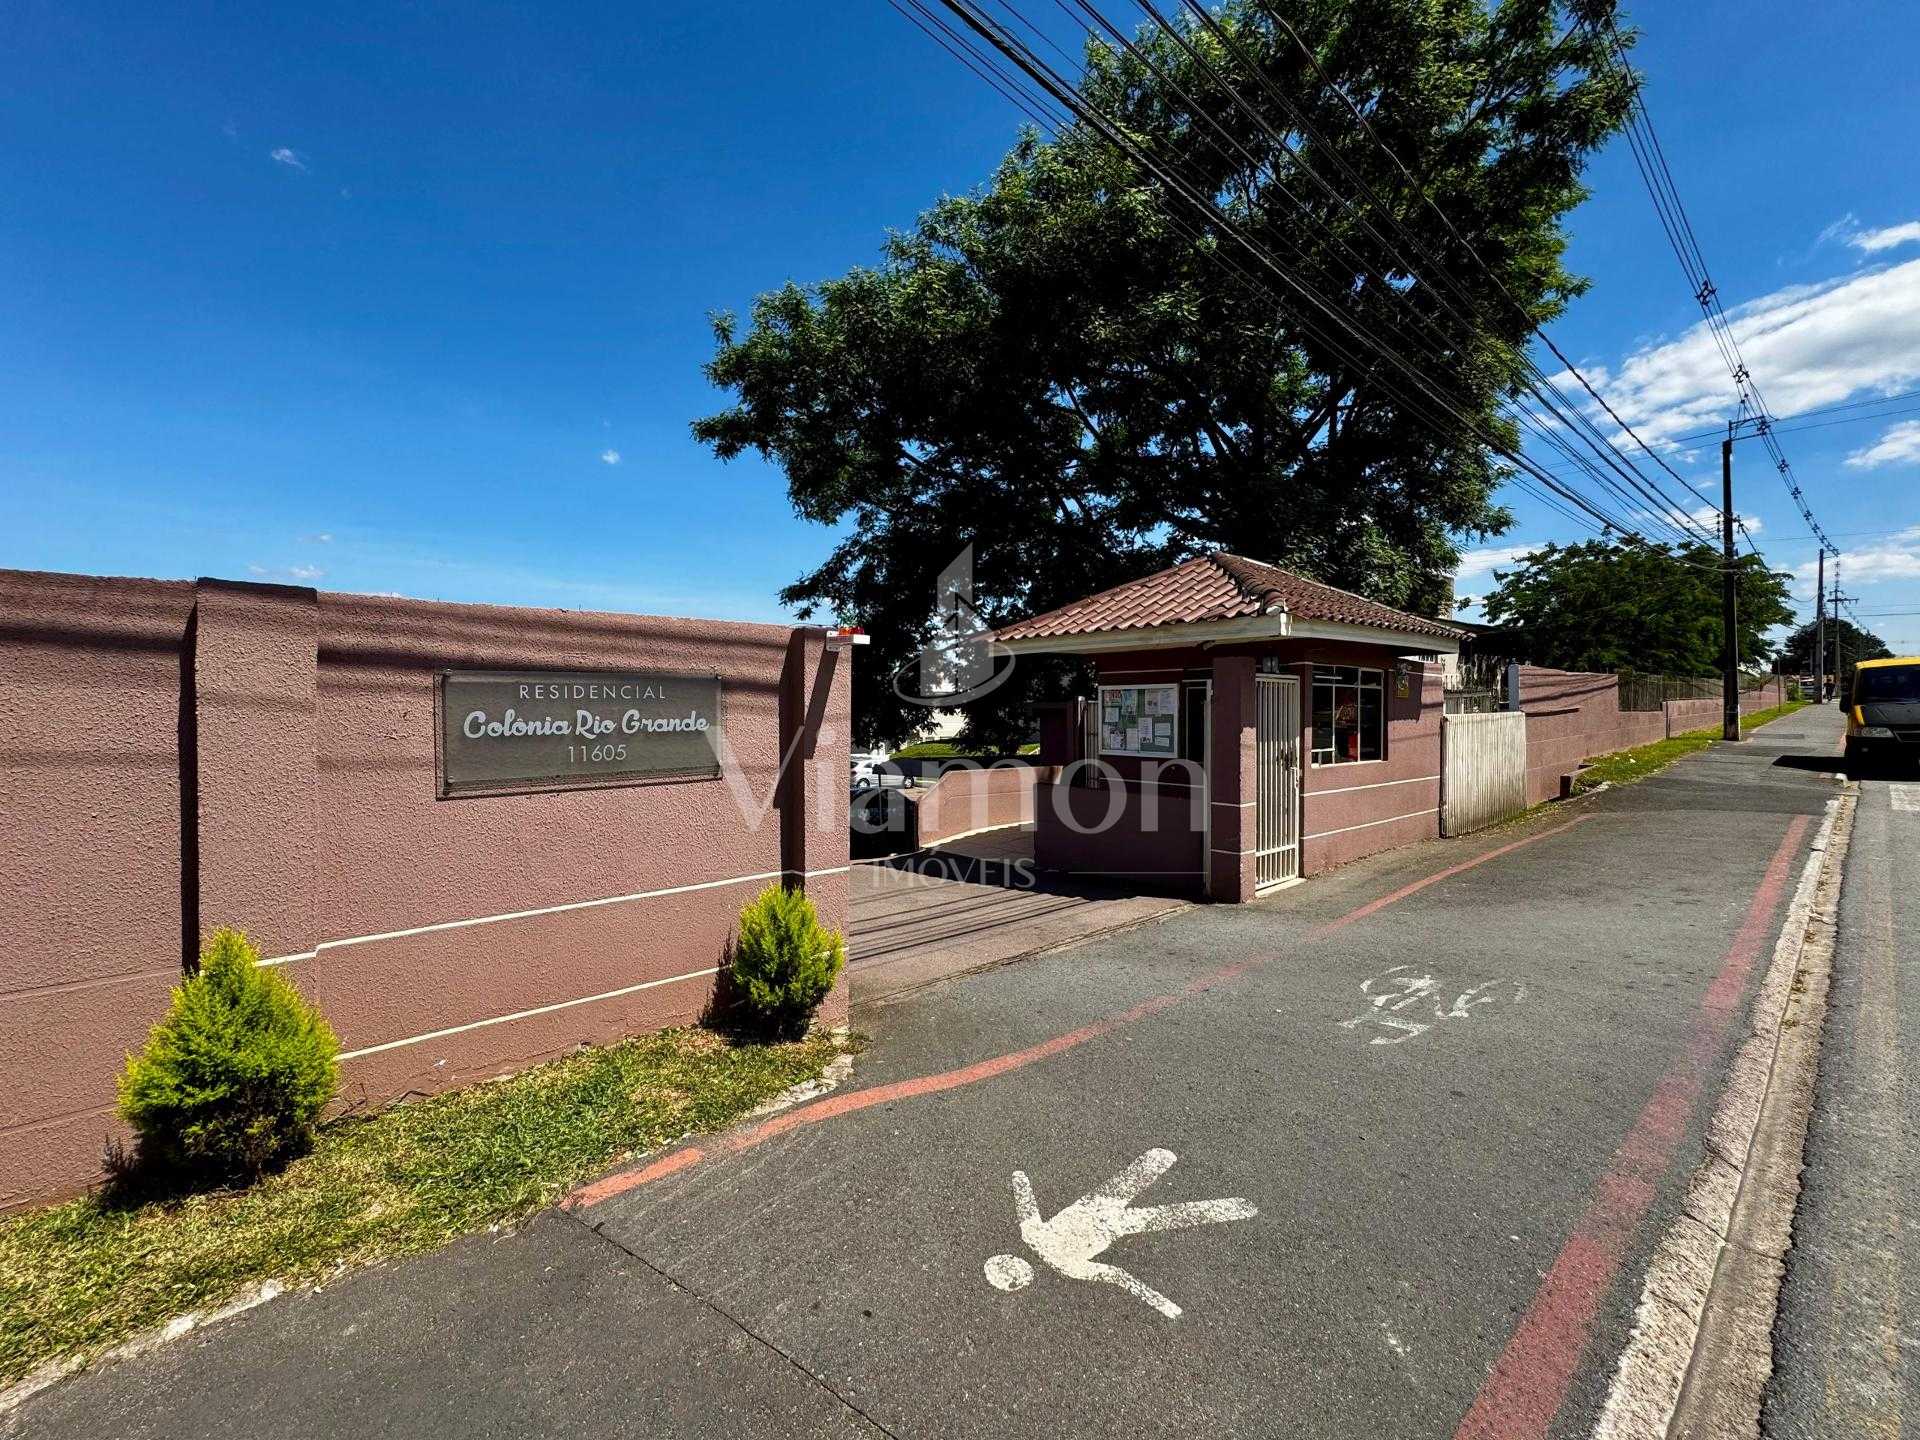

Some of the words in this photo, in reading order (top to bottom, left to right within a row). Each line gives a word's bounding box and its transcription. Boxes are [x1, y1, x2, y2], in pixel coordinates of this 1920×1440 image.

[519, 685, 666, 699] RESIDENCIAL
[463, 709, 573, 739] Colônia
[575, 709, 616, 739] Rio
[621, 709, 711, 735] Grande
[568, 745, 627, 762] 11605
